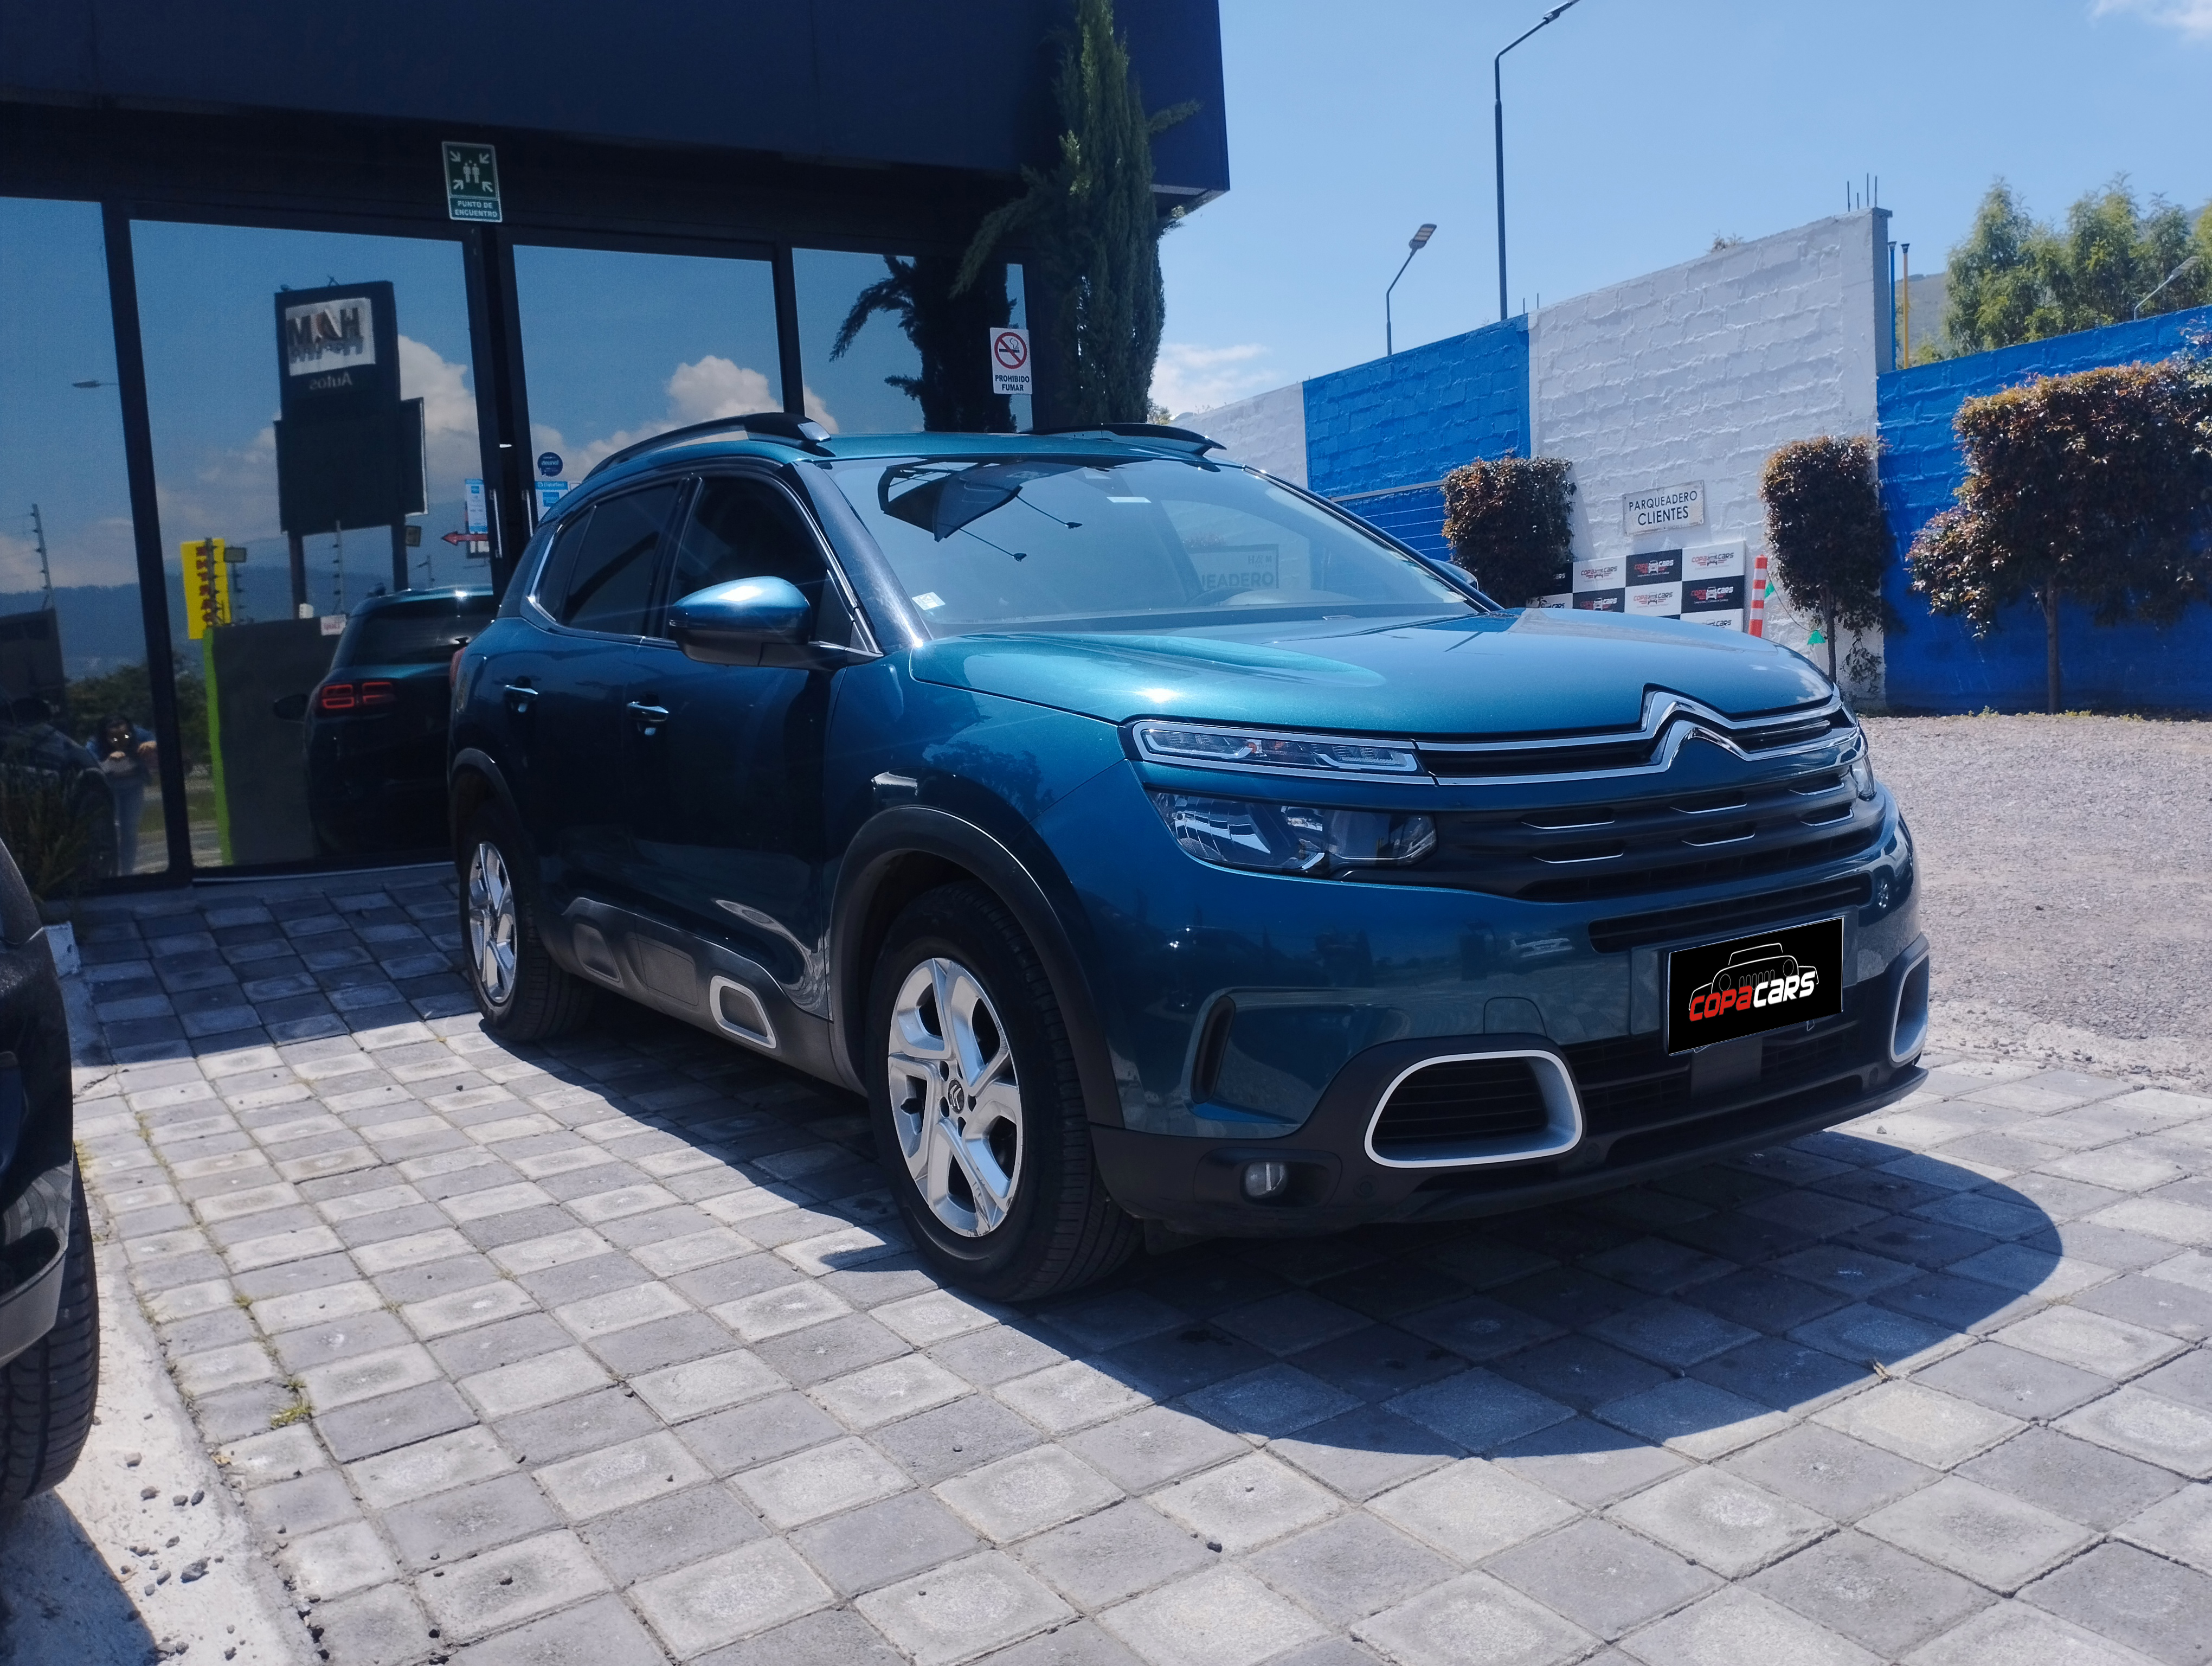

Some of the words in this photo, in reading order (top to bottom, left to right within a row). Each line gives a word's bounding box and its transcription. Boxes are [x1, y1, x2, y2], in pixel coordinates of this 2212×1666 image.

[454, 209, 498, 217] ENCUENTRO
[995, 375, 1030, 383] PROHIBIDO
[1629, 490, 1697, 511] PARQUEADERO
[1637, 506, 1689, 526] CLIENTES
